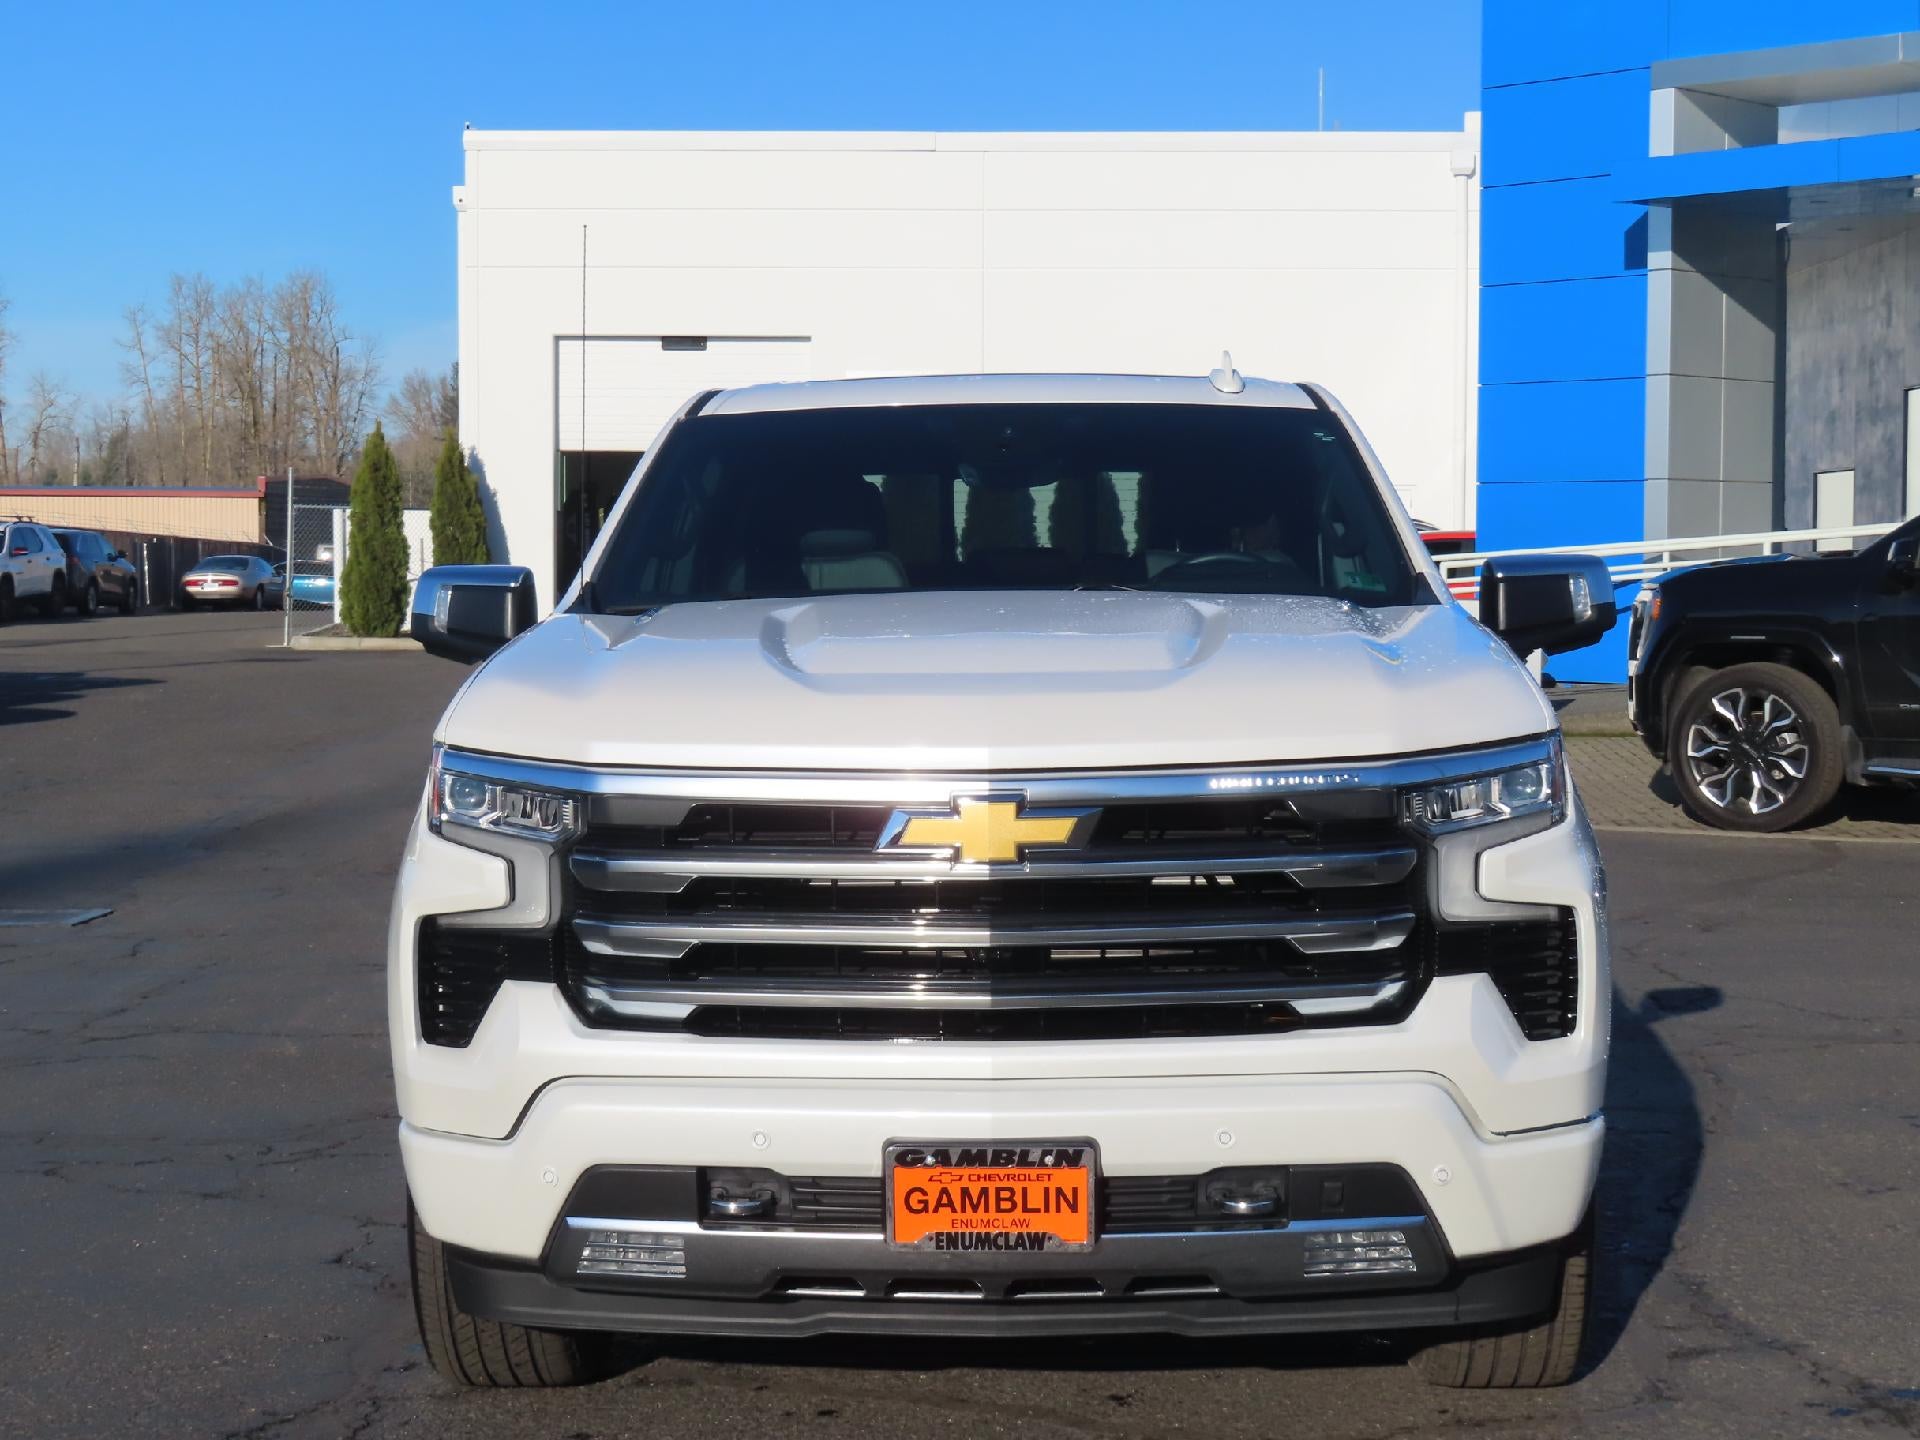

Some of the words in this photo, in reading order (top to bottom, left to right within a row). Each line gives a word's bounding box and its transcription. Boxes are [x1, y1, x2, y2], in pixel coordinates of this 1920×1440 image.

[895, 1149, 1084, 1167] GAMBLIN
[968, 1173, 1054, 1182] CHEVROLET
[904, 1187, 1079, 1214] GAMBLIN
[951, 1218, 1031, 1229] ENUMCLAW
[936, 1232, 1048, 1251] ENUMCLAW
